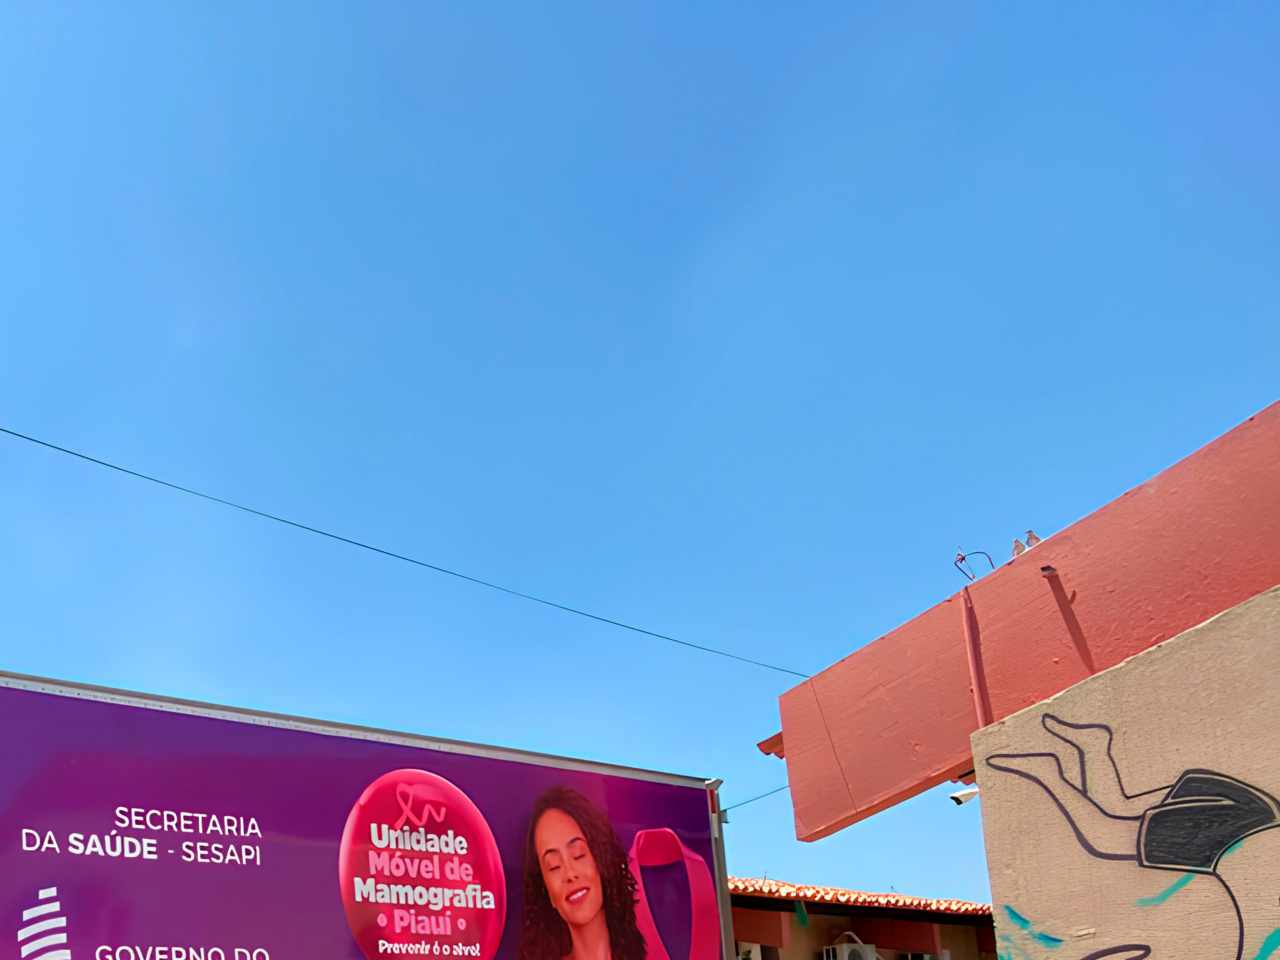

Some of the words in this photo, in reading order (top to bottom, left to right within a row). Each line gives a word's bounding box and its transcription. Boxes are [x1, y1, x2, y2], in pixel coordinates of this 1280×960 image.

[114, 806, 262, 838] SECRETARIA
[21, 829, 60, 853] DA
[67, 829, 158, 860] SAÚDE
[181, 841, 261, 866] SESAPI
[370, 823, 468, 855] Unidade
[368, 850, 440, 879] Móvel
[444, 856, 473, 881] de
[353, 877, 495, 911] Mamografia
[393, 909, 452, 936] Piauí
[442, 944, 450, 955] o
